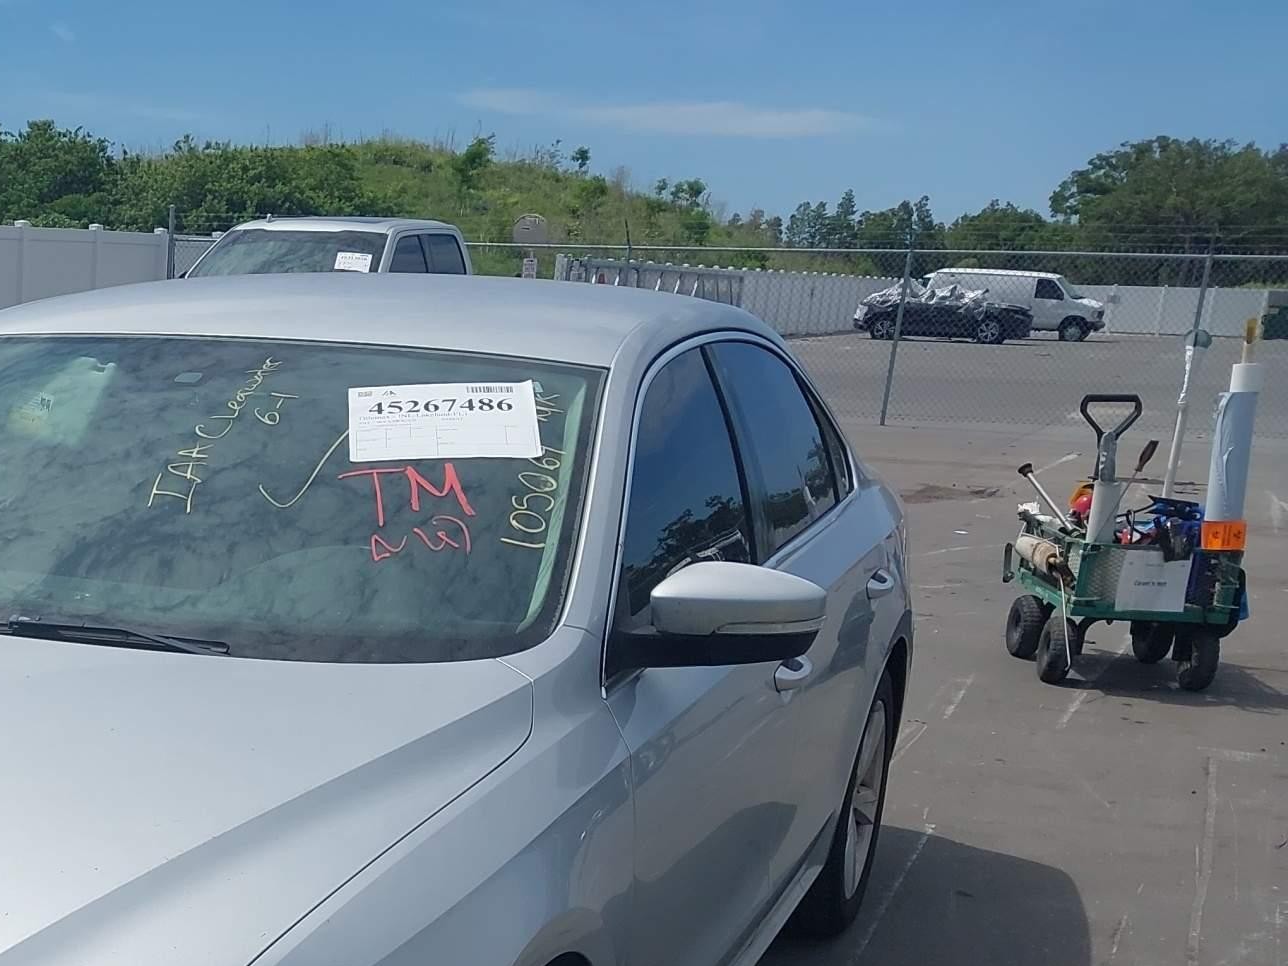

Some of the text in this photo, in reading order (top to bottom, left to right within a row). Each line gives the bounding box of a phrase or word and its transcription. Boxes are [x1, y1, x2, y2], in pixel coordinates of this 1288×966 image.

[368, 398, 514, 415] 45267486
[147, 442, 214, 514] IAA
[337, 462, 476, 527] TM
